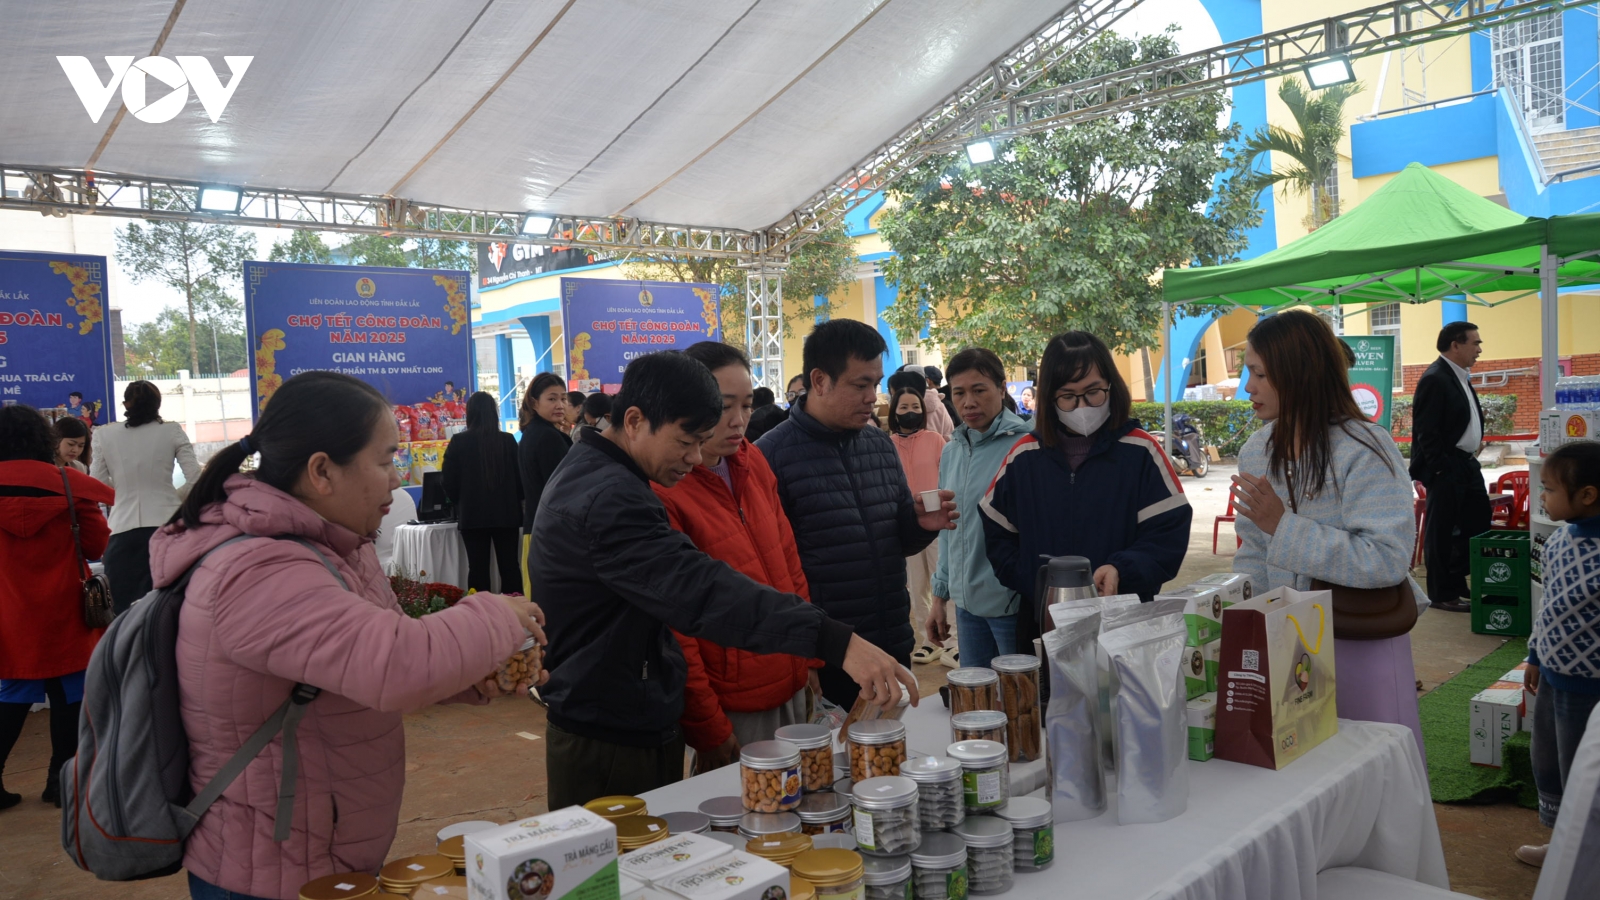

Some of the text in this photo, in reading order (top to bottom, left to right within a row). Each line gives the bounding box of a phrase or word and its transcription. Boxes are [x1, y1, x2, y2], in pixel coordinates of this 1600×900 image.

[512, 243, 544, 261] GYM
[324, 298, 344, 306] ĐOÀN
[360, 299, 380, 307] ĐỘNG
[381, 299, 394, 307] TỈNH
[287, 312, 441, 330] CHỢ TẾT CÔNG ĐOÀN
[592, 318, 700, 333] CHỢ TẾT CÔNG ĐOÀN
[329, 329, 406, 344] NĂM 2025
[622, 332, 675, 344] NĂM 2025
[332, 349, 406, 363] GIAN HÀNG
[401, 364, 421, 374] NHẤT
[24, 372, 51, 382] TRÁI
[53, 373, 75, 382] CÂY
[4, 385, 22, 395] MÊ
[564, 849, 578, 863] TRÀ
[578, 845, 600, 859] MÃNG
